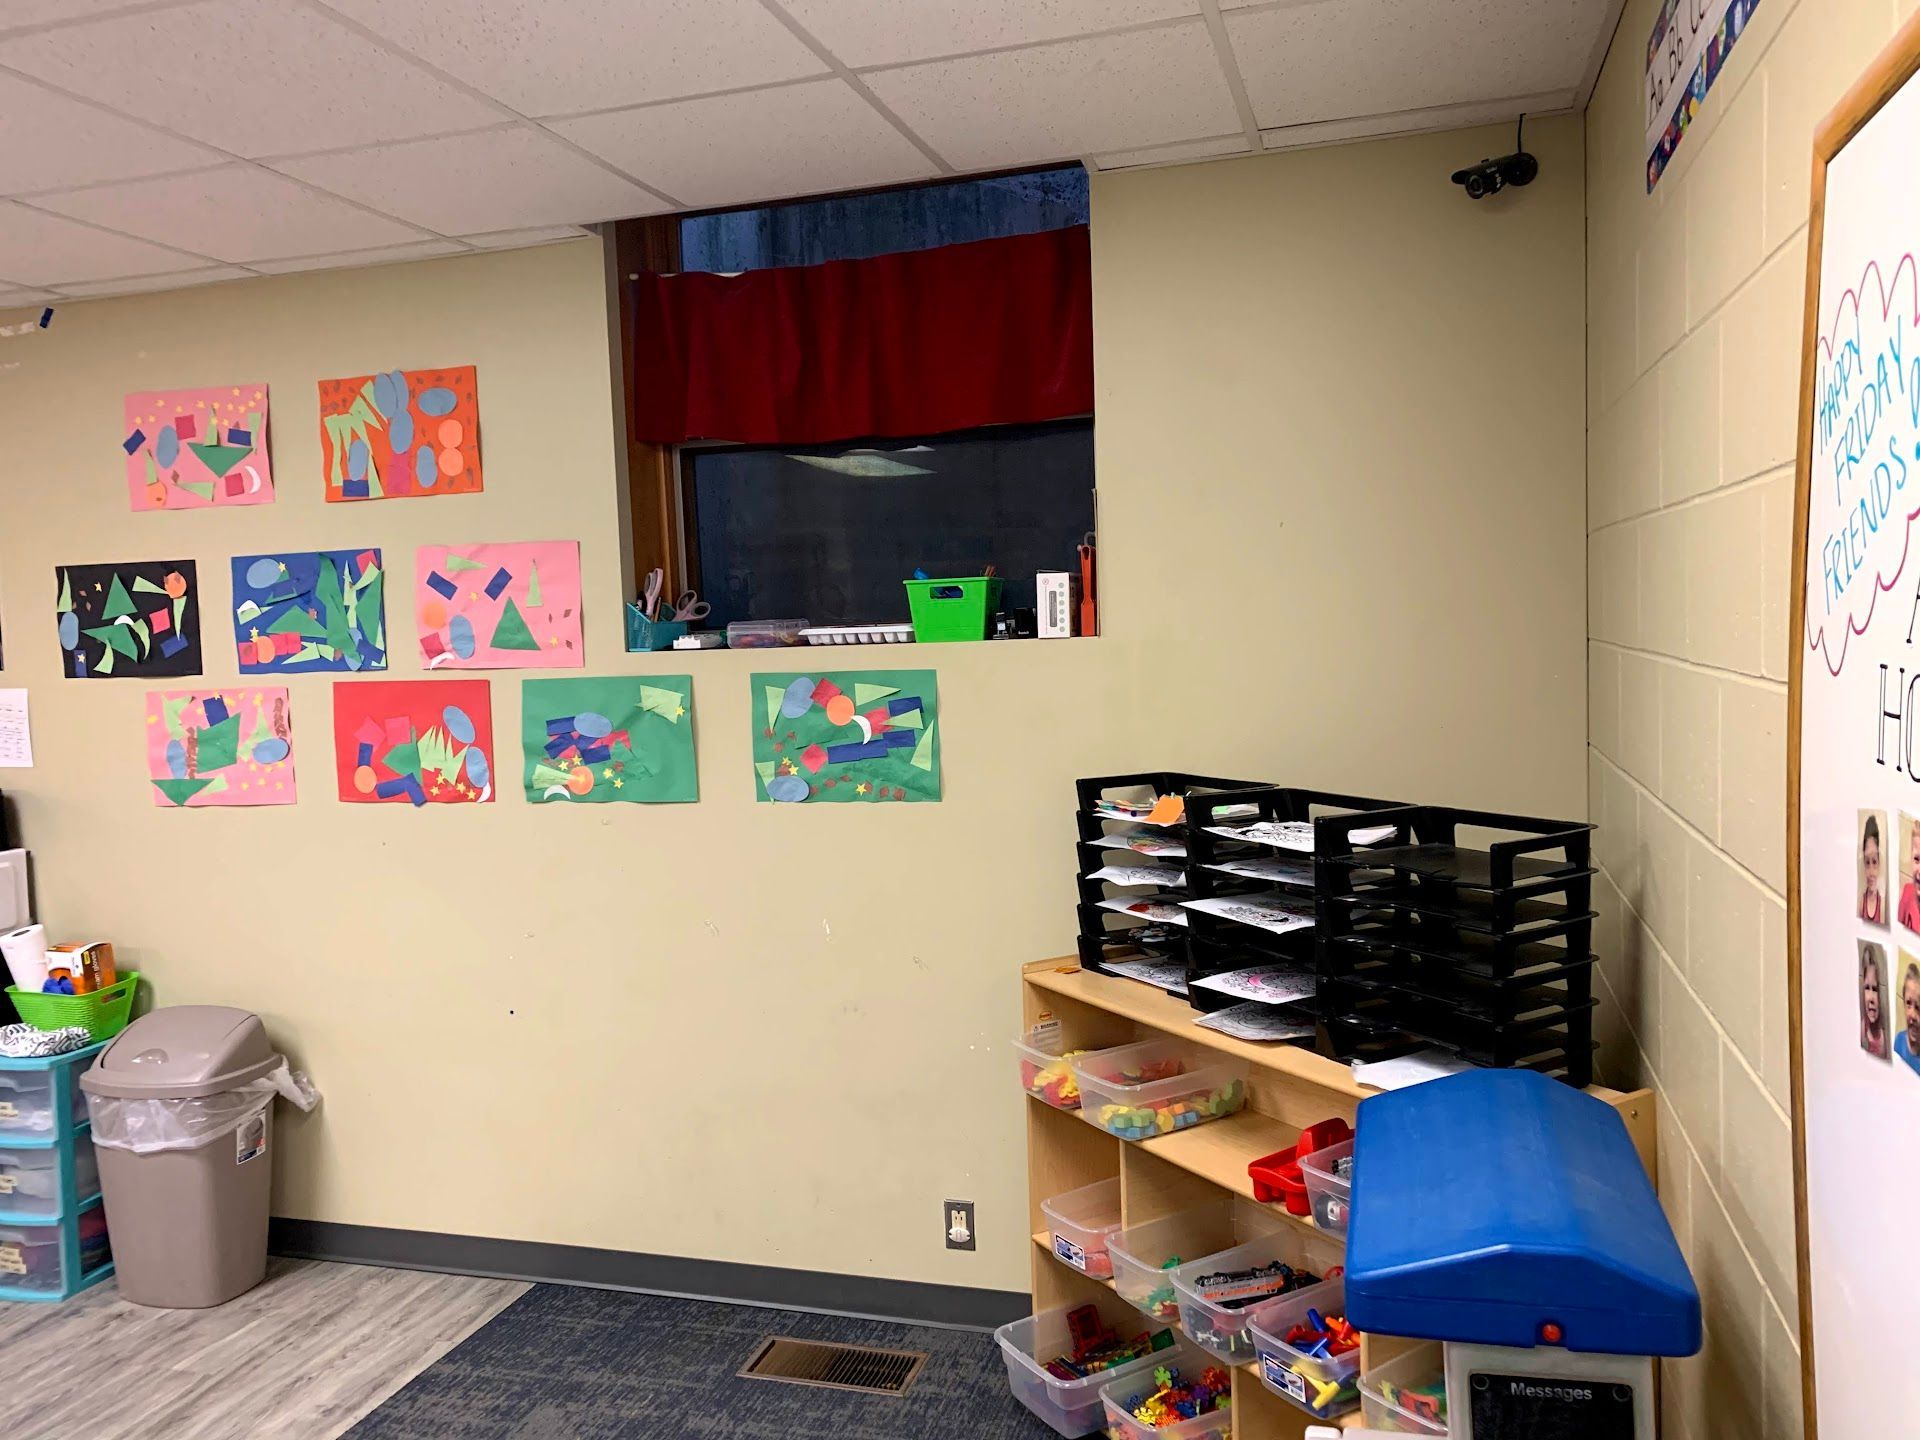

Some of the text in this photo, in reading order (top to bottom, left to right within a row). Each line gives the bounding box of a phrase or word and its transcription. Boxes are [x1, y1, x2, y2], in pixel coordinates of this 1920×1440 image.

[1668, 14, 1684, 84] Bb
[1818, 313, 1863, 456] HAPPY
[1834, 314, 1904, 507] FRIDAY
[1510, 1382, 1593, 1401] Messages
